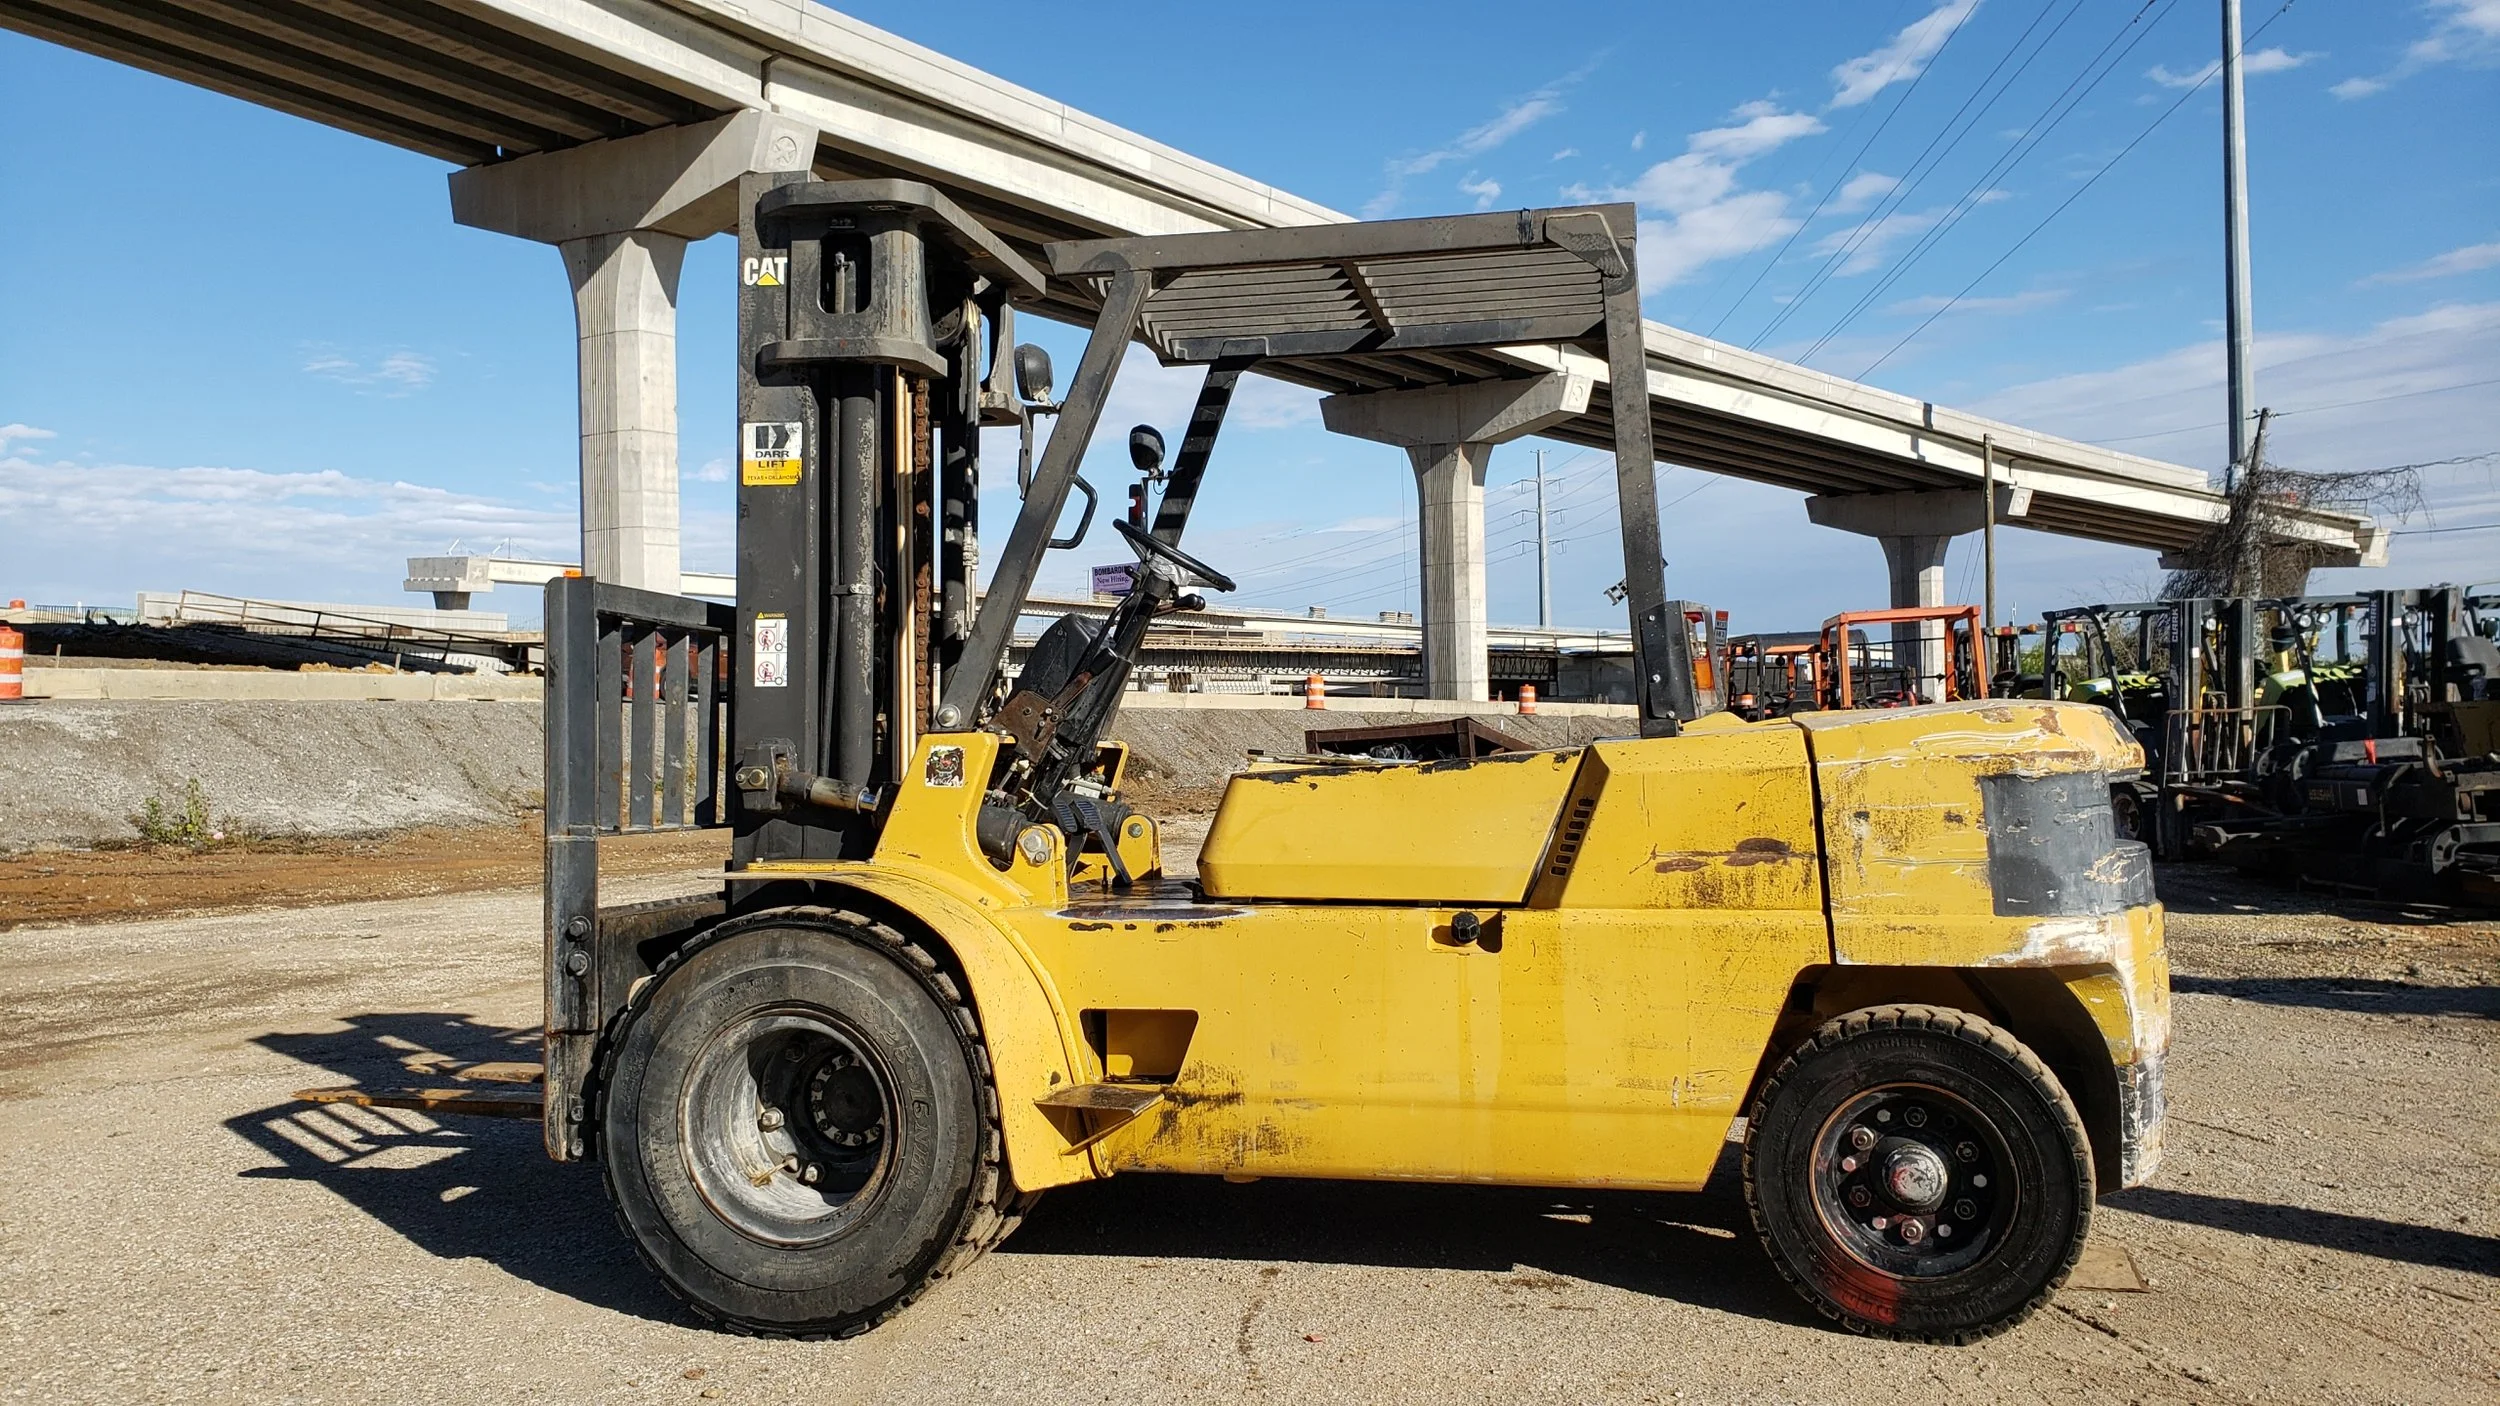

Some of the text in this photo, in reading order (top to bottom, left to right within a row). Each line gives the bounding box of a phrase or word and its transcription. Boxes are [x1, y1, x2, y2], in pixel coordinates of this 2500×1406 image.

[744, 257, 788, 286] CAT
[755, 450, 790, 458] DARR
[758, 460, 788, 469] LIFT
